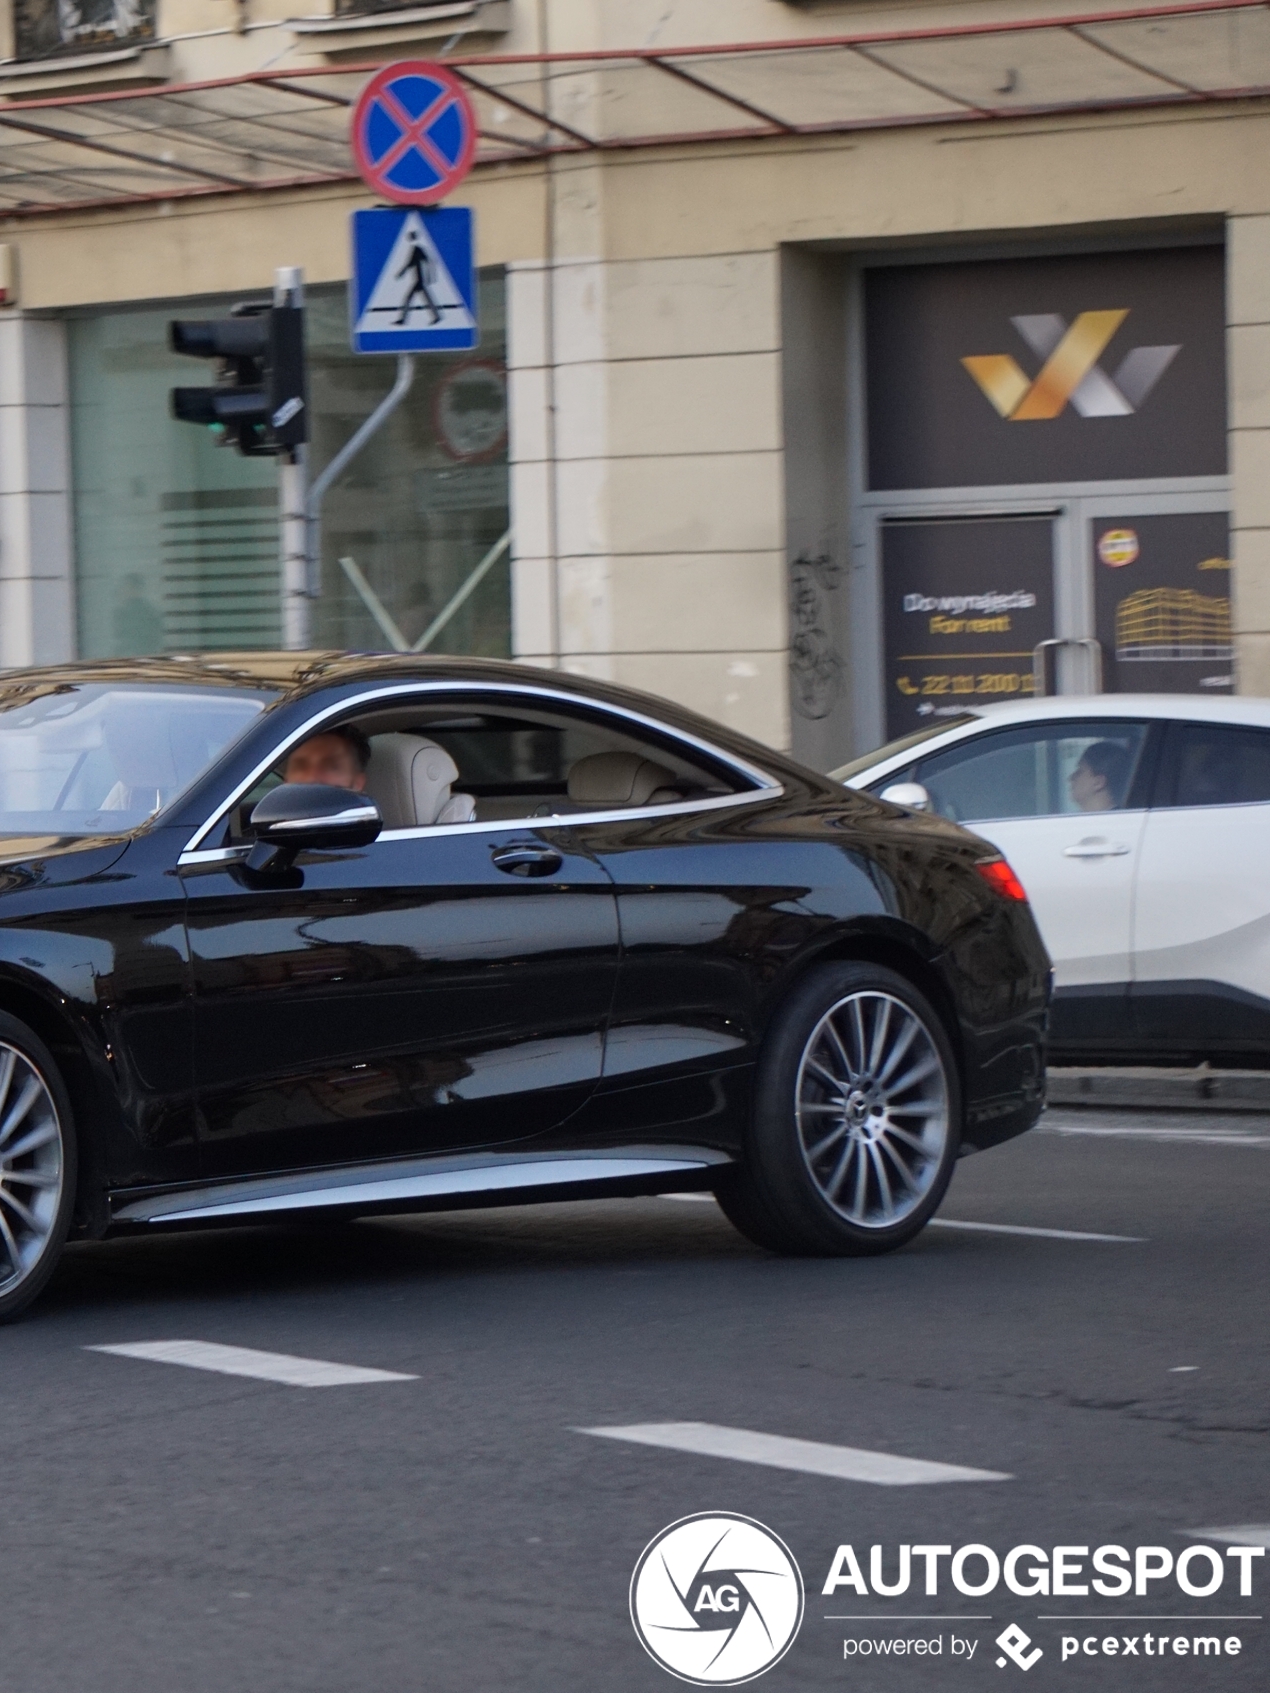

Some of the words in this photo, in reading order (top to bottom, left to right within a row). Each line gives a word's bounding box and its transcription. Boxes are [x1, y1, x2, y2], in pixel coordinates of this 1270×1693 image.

[903, 593, 937, 612] Do
[937, 589, 1036, 614] wynajęcia
[930, 615, 964, 633] For
[966, 615, 1011, 633] rent
